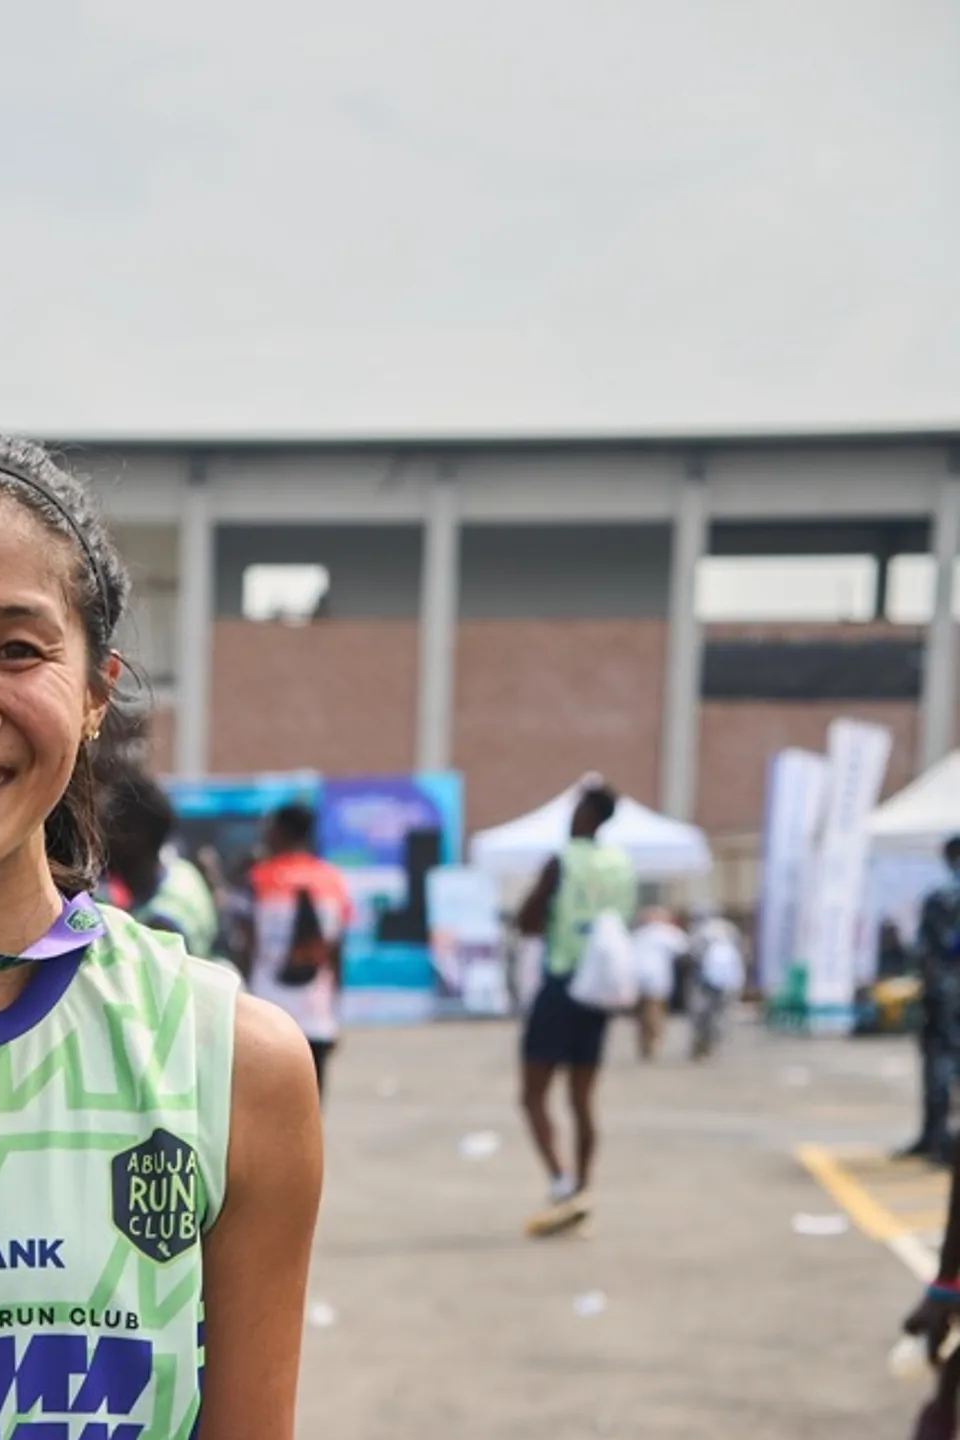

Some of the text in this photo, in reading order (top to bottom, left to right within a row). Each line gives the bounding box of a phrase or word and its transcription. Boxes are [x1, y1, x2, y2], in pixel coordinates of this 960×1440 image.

[126, 1147, 198, 1175] ABUJA
[128, 1174, 196, 1214] RUN
[128, 1211, 196, 1239] CLUB
[69, 1308, 140, 1330] CLUB
